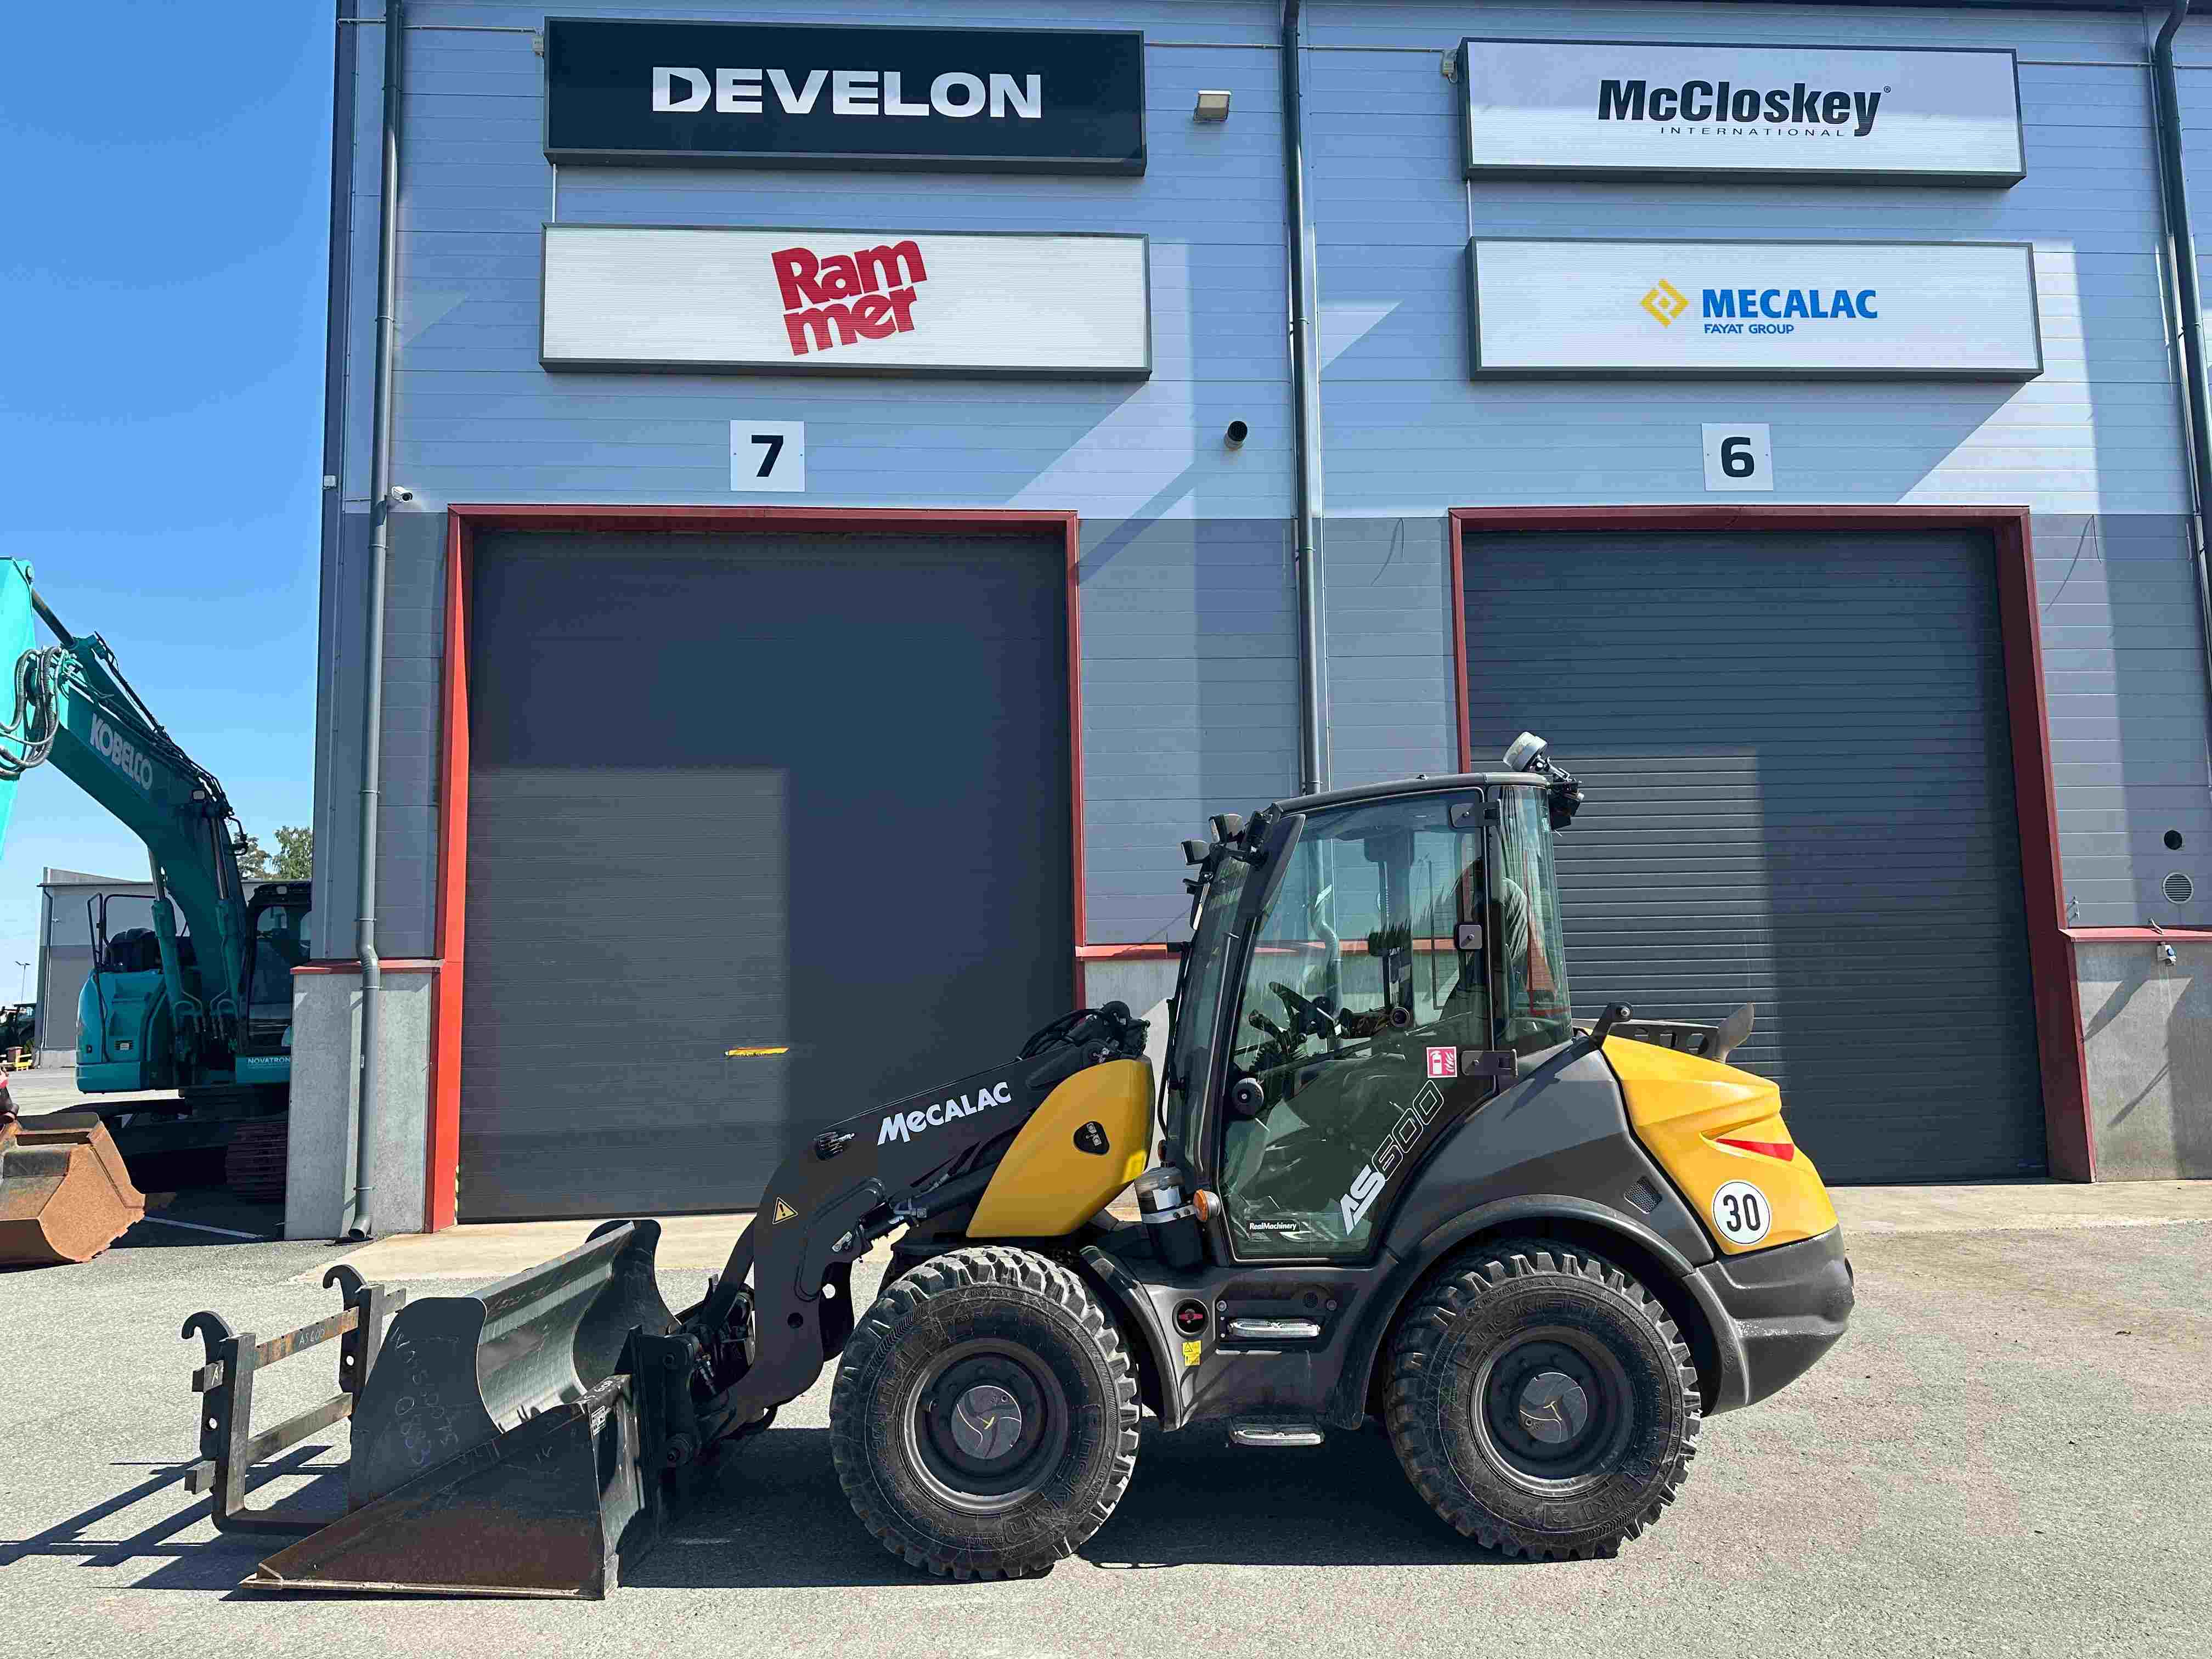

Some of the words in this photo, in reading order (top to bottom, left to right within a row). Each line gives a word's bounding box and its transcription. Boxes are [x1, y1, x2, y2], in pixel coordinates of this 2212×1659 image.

[653, 66, 1041, 119] DEVELON
[1598, 80, 1882, 137] McCloskey
[1661, 127, 1844, 137] INTERNATIONAL
[771, 240, 927, 311] Ram
[1702, 289, 1878, 319] MECALAC
[1703, 324, 1744, 334] FAYAT
[1748, 324, 1795, 334] GROUP
[751, 435, 784, 477] 7
[1720, 437, 1754, 477] 6
[90, 713, 153, 790] KOBELCO
[1249, 1222, 1297, 1231] RealMachinery
[1723, 1193, 1760, 1232] 30
